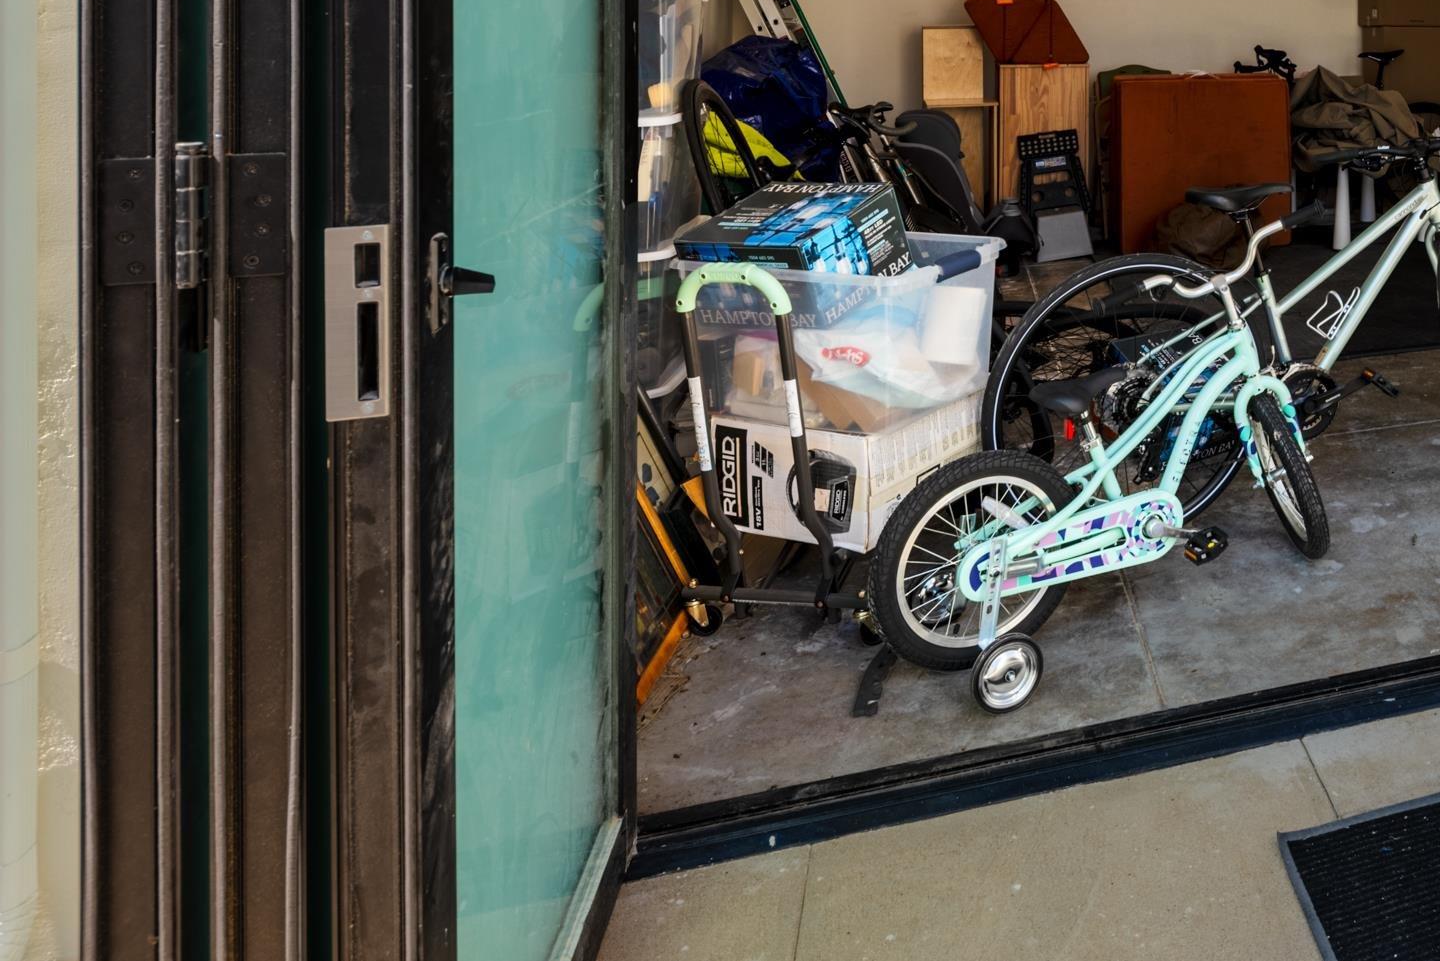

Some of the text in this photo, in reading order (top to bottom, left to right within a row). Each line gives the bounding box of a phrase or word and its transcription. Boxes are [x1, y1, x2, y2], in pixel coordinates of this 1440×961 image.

[763, 183, 884, 193] HAMPTON BAY
[888, 251, 912, 278] BAY
[720, 434, 739, 517] RIDGID
[833, 489, 843, 515] RIDGID
[754, 508, 764, 528] 18V
